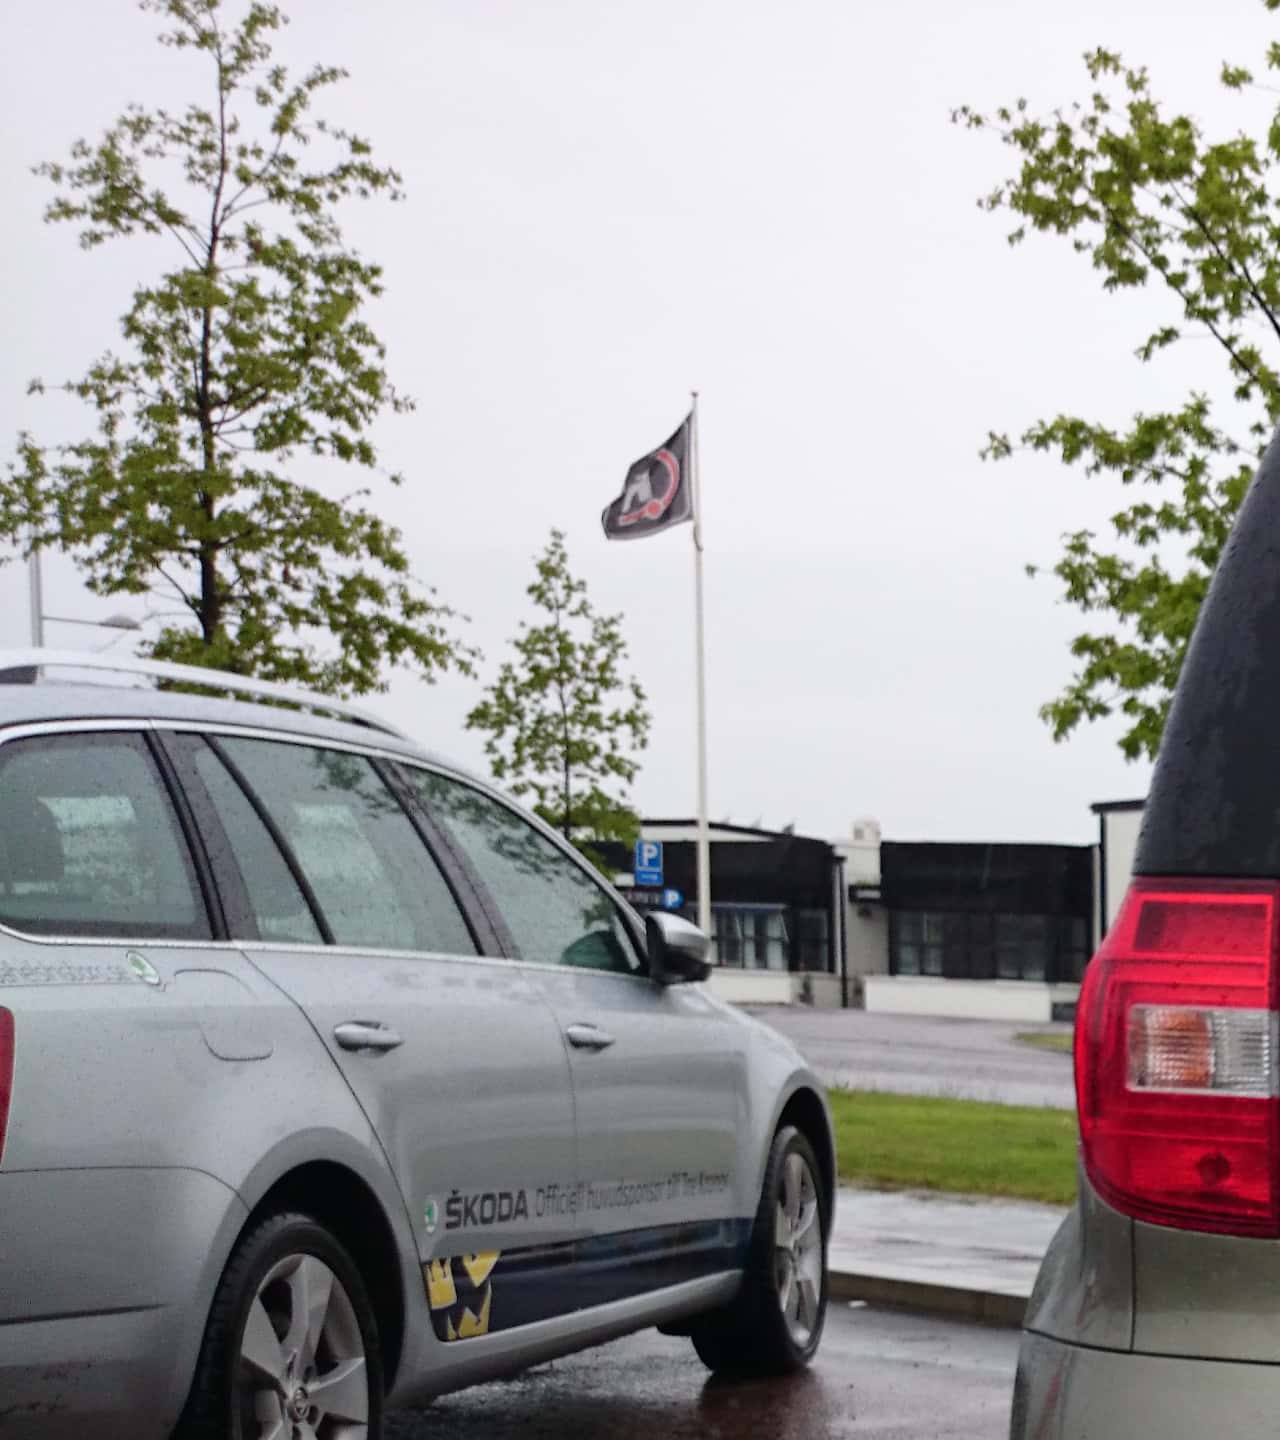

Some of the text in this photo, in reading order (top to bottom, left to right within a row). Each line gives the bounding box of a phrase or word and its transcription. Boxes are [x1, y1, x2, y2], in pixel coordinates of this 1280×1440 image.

[643, 844, 658, 867] P
[665, 888, 681, 909] P
[445, 1189, 528, 1230] ŠKODA
